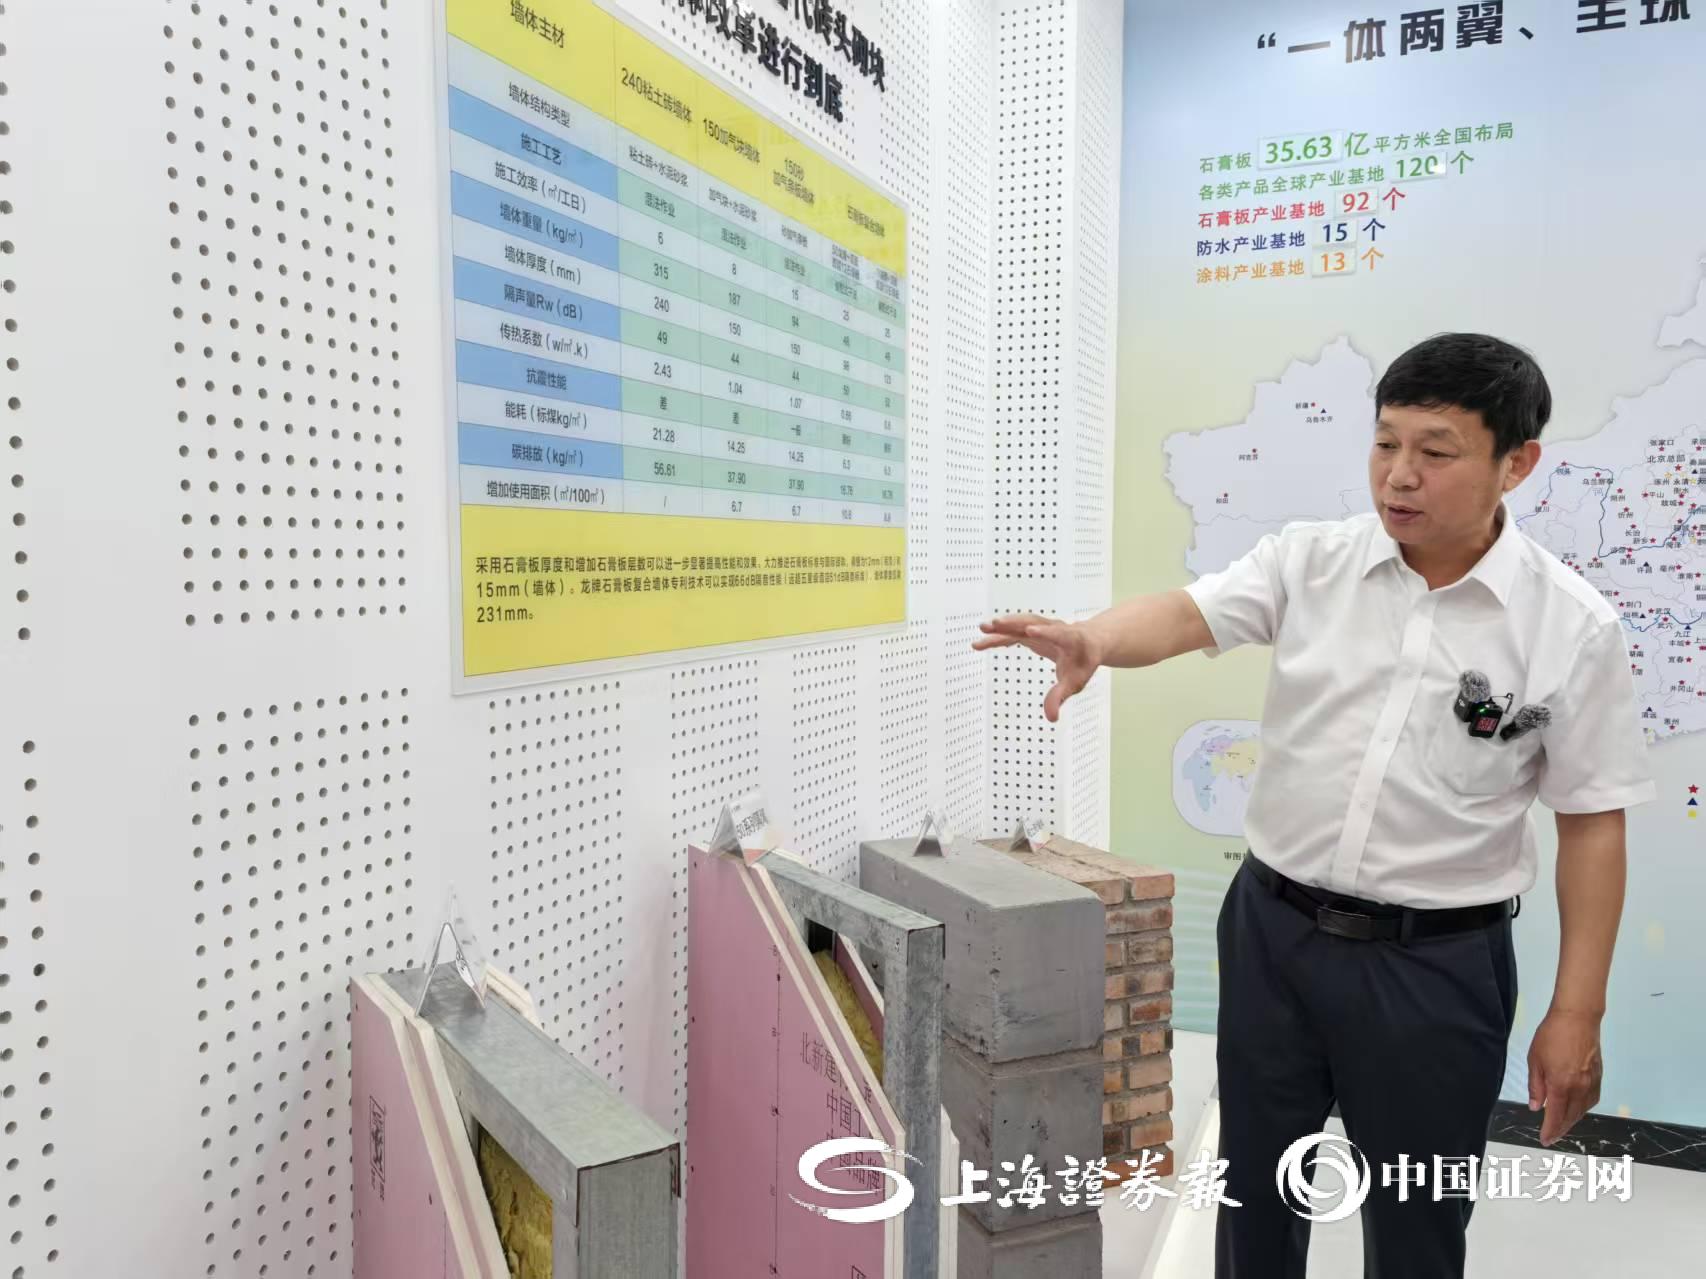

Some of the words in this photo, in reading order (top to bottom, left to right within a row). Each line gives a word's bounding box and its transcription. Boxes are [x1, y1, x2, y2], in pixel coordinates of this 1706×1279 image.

[509, 0, 565, 48] 墙体主材
[777, 0, 884, 92] 代砖头砌块
[508, 82, 570, 128] 墙体结构类型
[520, 132, 562, 165] 施工工艺
[1199, 151, 1252, 174] 石膏板
[1264, 135, 1333, 164] 35.63
[1198, 165, 1385, 201] 各类产品全球产业基地
[1395, 155, 1440, 178] 120
[1451, 151, 1474, 175] 个
[1198, 200, 1325, 229] 石膏板产业基地
[1341, 192, 1370, 213] 92
[1382, 188, 1406, 212] 个
[657, 232, 664, 245] 6
[1196, 232, 1306, 256] 防水产业基地
[1322, 223, 1348, 242] 15
[1362, 219, 1386, 242] 个
[653, 262, 669, 280] 315
[731, 263, 737, 275] 8
[1196, 260, 1305, 284] 涂料产业基地
[1320, 253, 1346, 272] 13
[1361, 248, 1384, 270] 个
[728, 292, 741, 306] 187
[791, 289, 799, 301] 15
[654, 296, 670, 313] 240
[728, 321, 742, 336] 150
[657, 330, 668, 345] 49
[730, 352, 740, 366] 44
[654, 362, 672, 379] 2.43
[791, 370, 800, 382] 44
[527, 368, 567, 391] 抗震性能
[728, 381, 743, 395] 1.04
[659, 396, 668, 411] 差
[653, 428, 675, 443] 21.28
[727, 440, 745, 454] 14.25
[1647, 454, 1685, 463] 北京总部
[653, 462, 676, 477] 56.61
[727, 472, 746, 485] 37.90
[731, 501, 742, 513] 6.7
[1674, 630, 1691, 638] 九江
[1670, 684, 1694, 692] 井冈山
